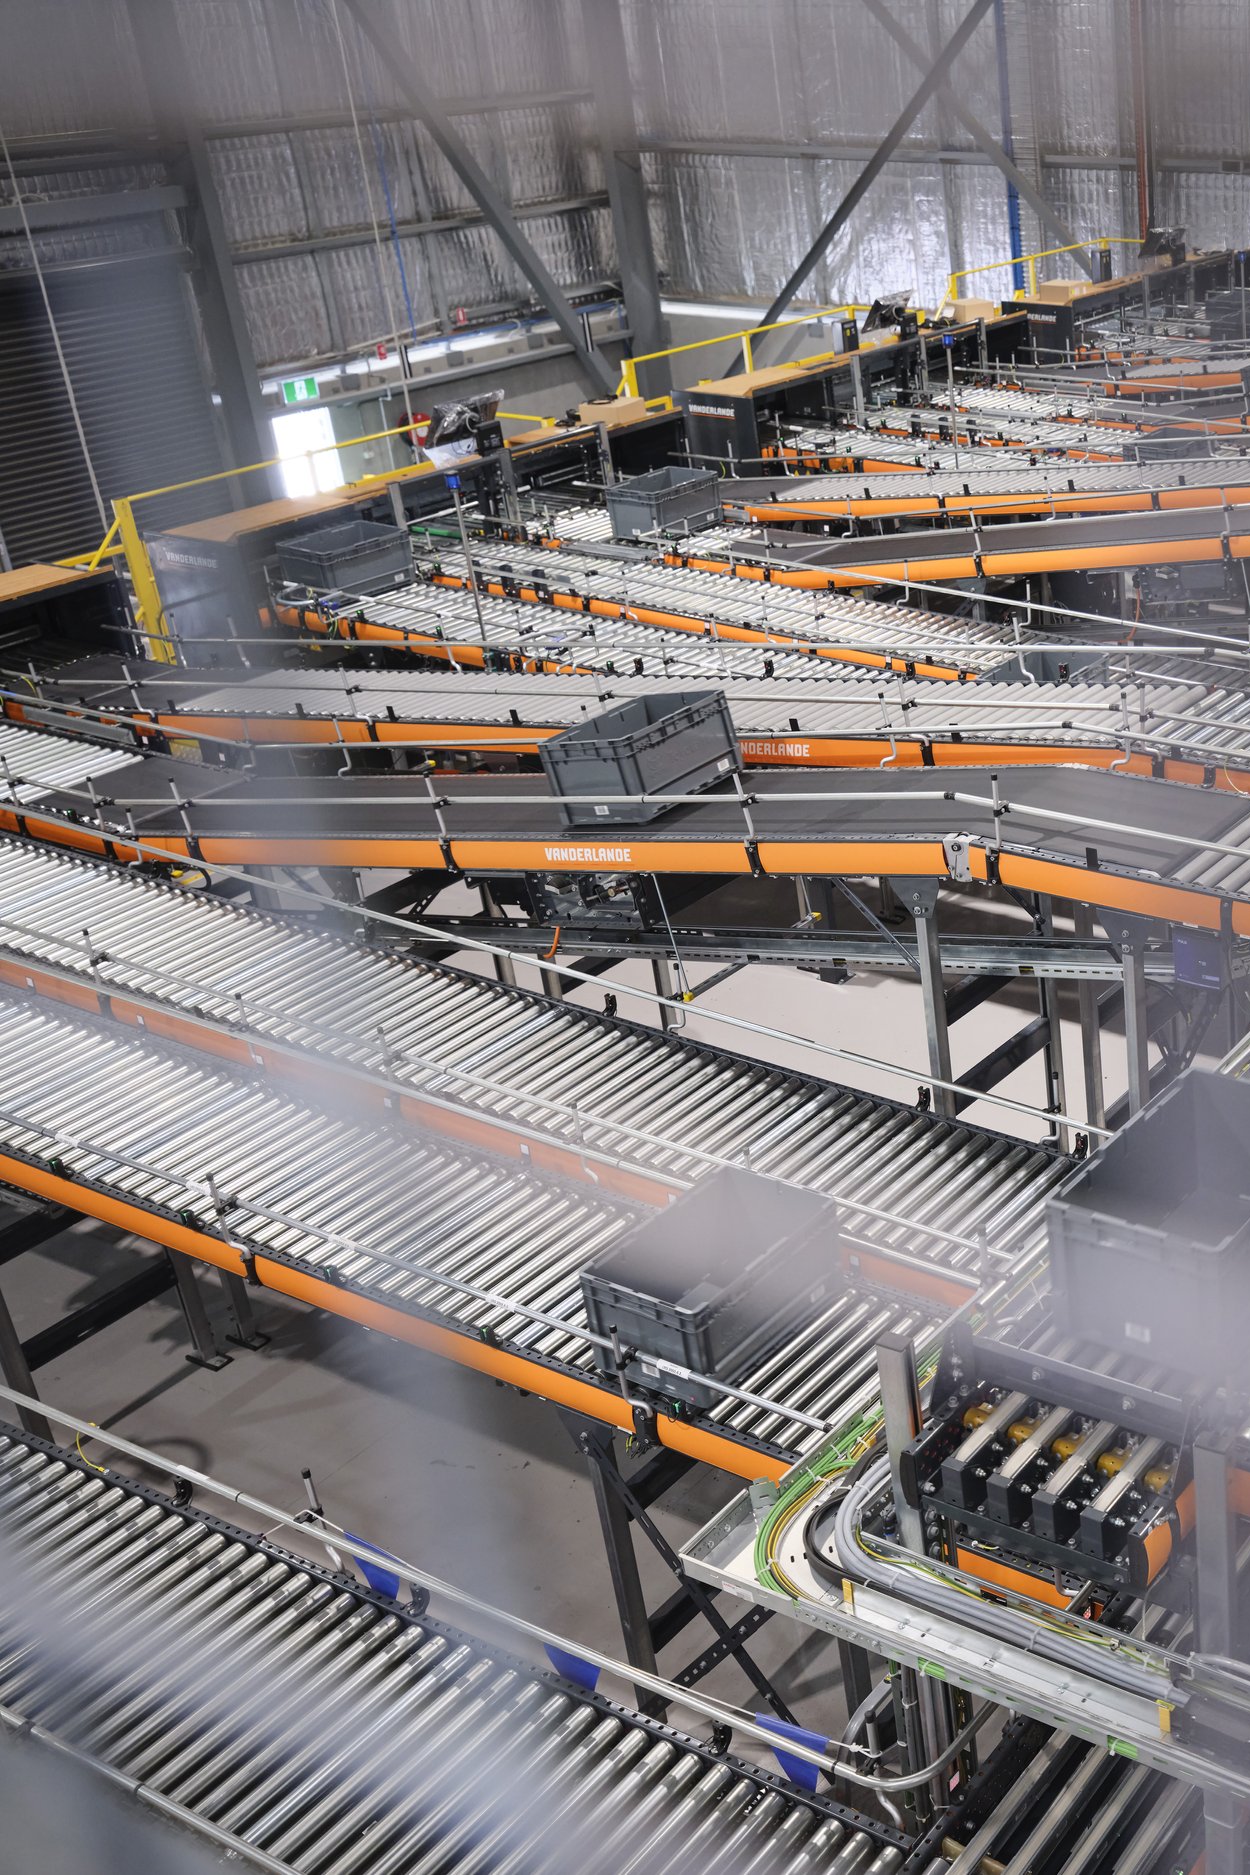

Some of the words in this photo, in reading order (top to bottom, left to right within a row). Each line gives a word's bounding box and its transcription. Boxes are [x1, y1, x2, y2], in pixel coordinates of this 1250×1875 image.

[1026, 313, 1057, 323] DERLANDE
[688, 404, 736, 417] VANDERLANDE
[165, 551, 218, 569] VANDERLANDE
[740, 742, 811, 758] NDERLANDE
[544, 847, 632, 862] VANDERLANDE
